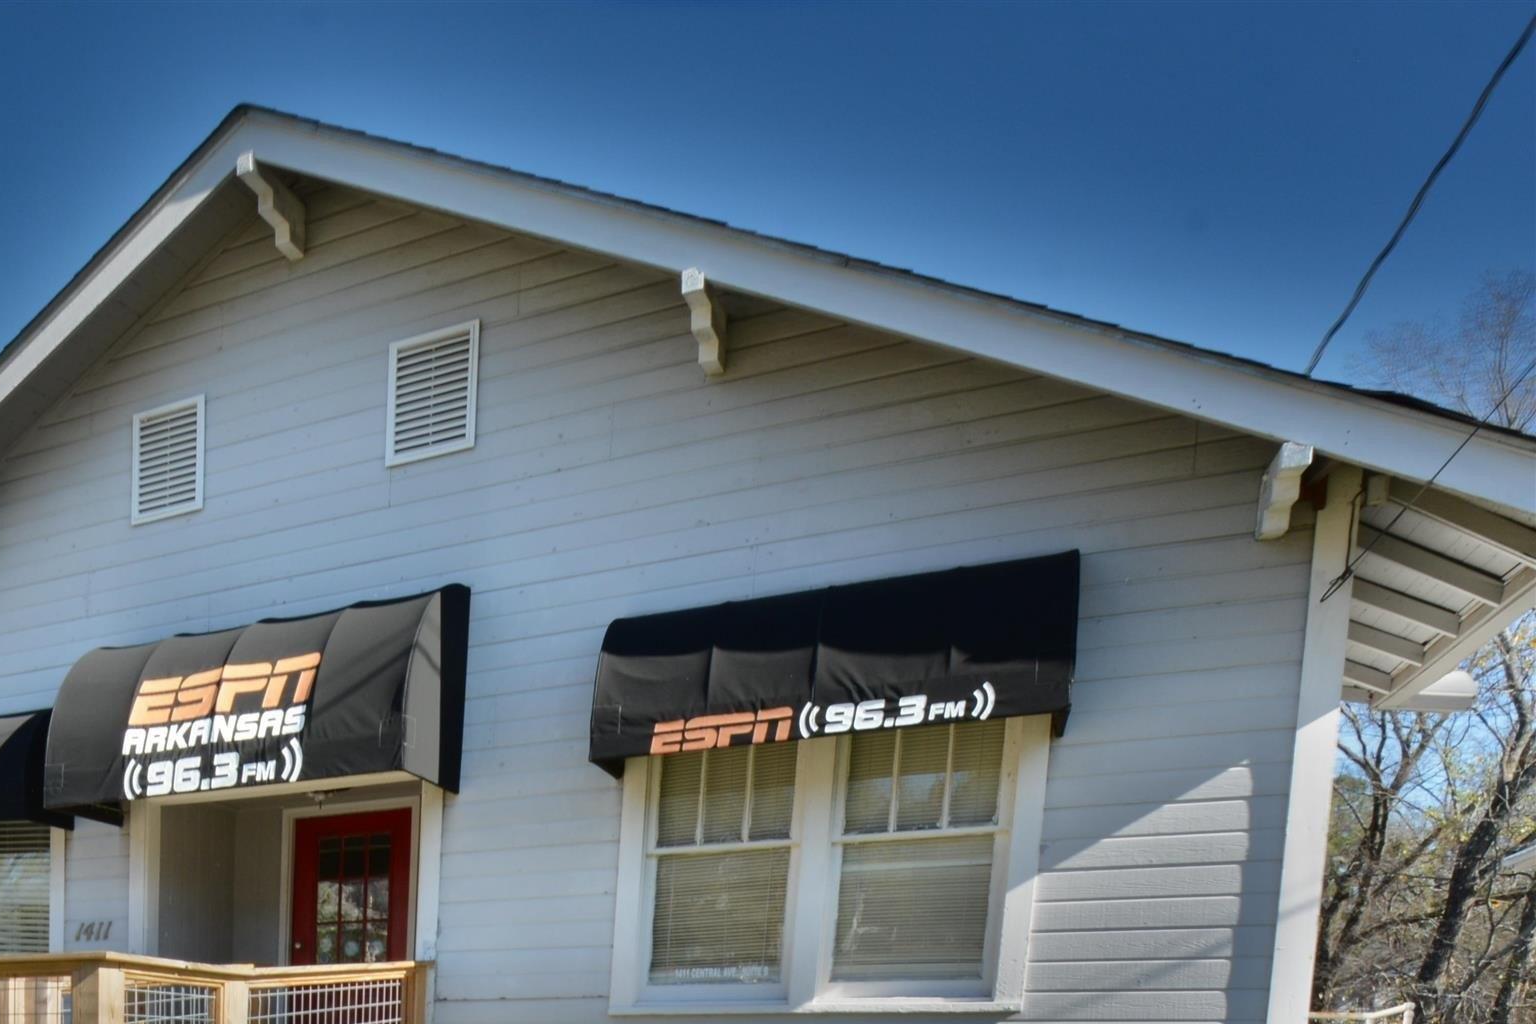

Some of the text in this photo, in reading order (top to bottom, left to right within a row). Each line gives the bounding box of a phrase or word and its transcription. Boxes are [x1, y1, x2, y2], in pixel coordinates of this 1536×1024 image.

[128, 652, 321, 726] ESPN
[122, 705, 307, 755] ARKANSAS
[650, 694, 967, 755] ESPN 96.3 FM
[146, 752, 276, 797] 96.3 FM
[75, 921, 112, 942] 1411
[691, 967, 721, 978] CENTRAL
